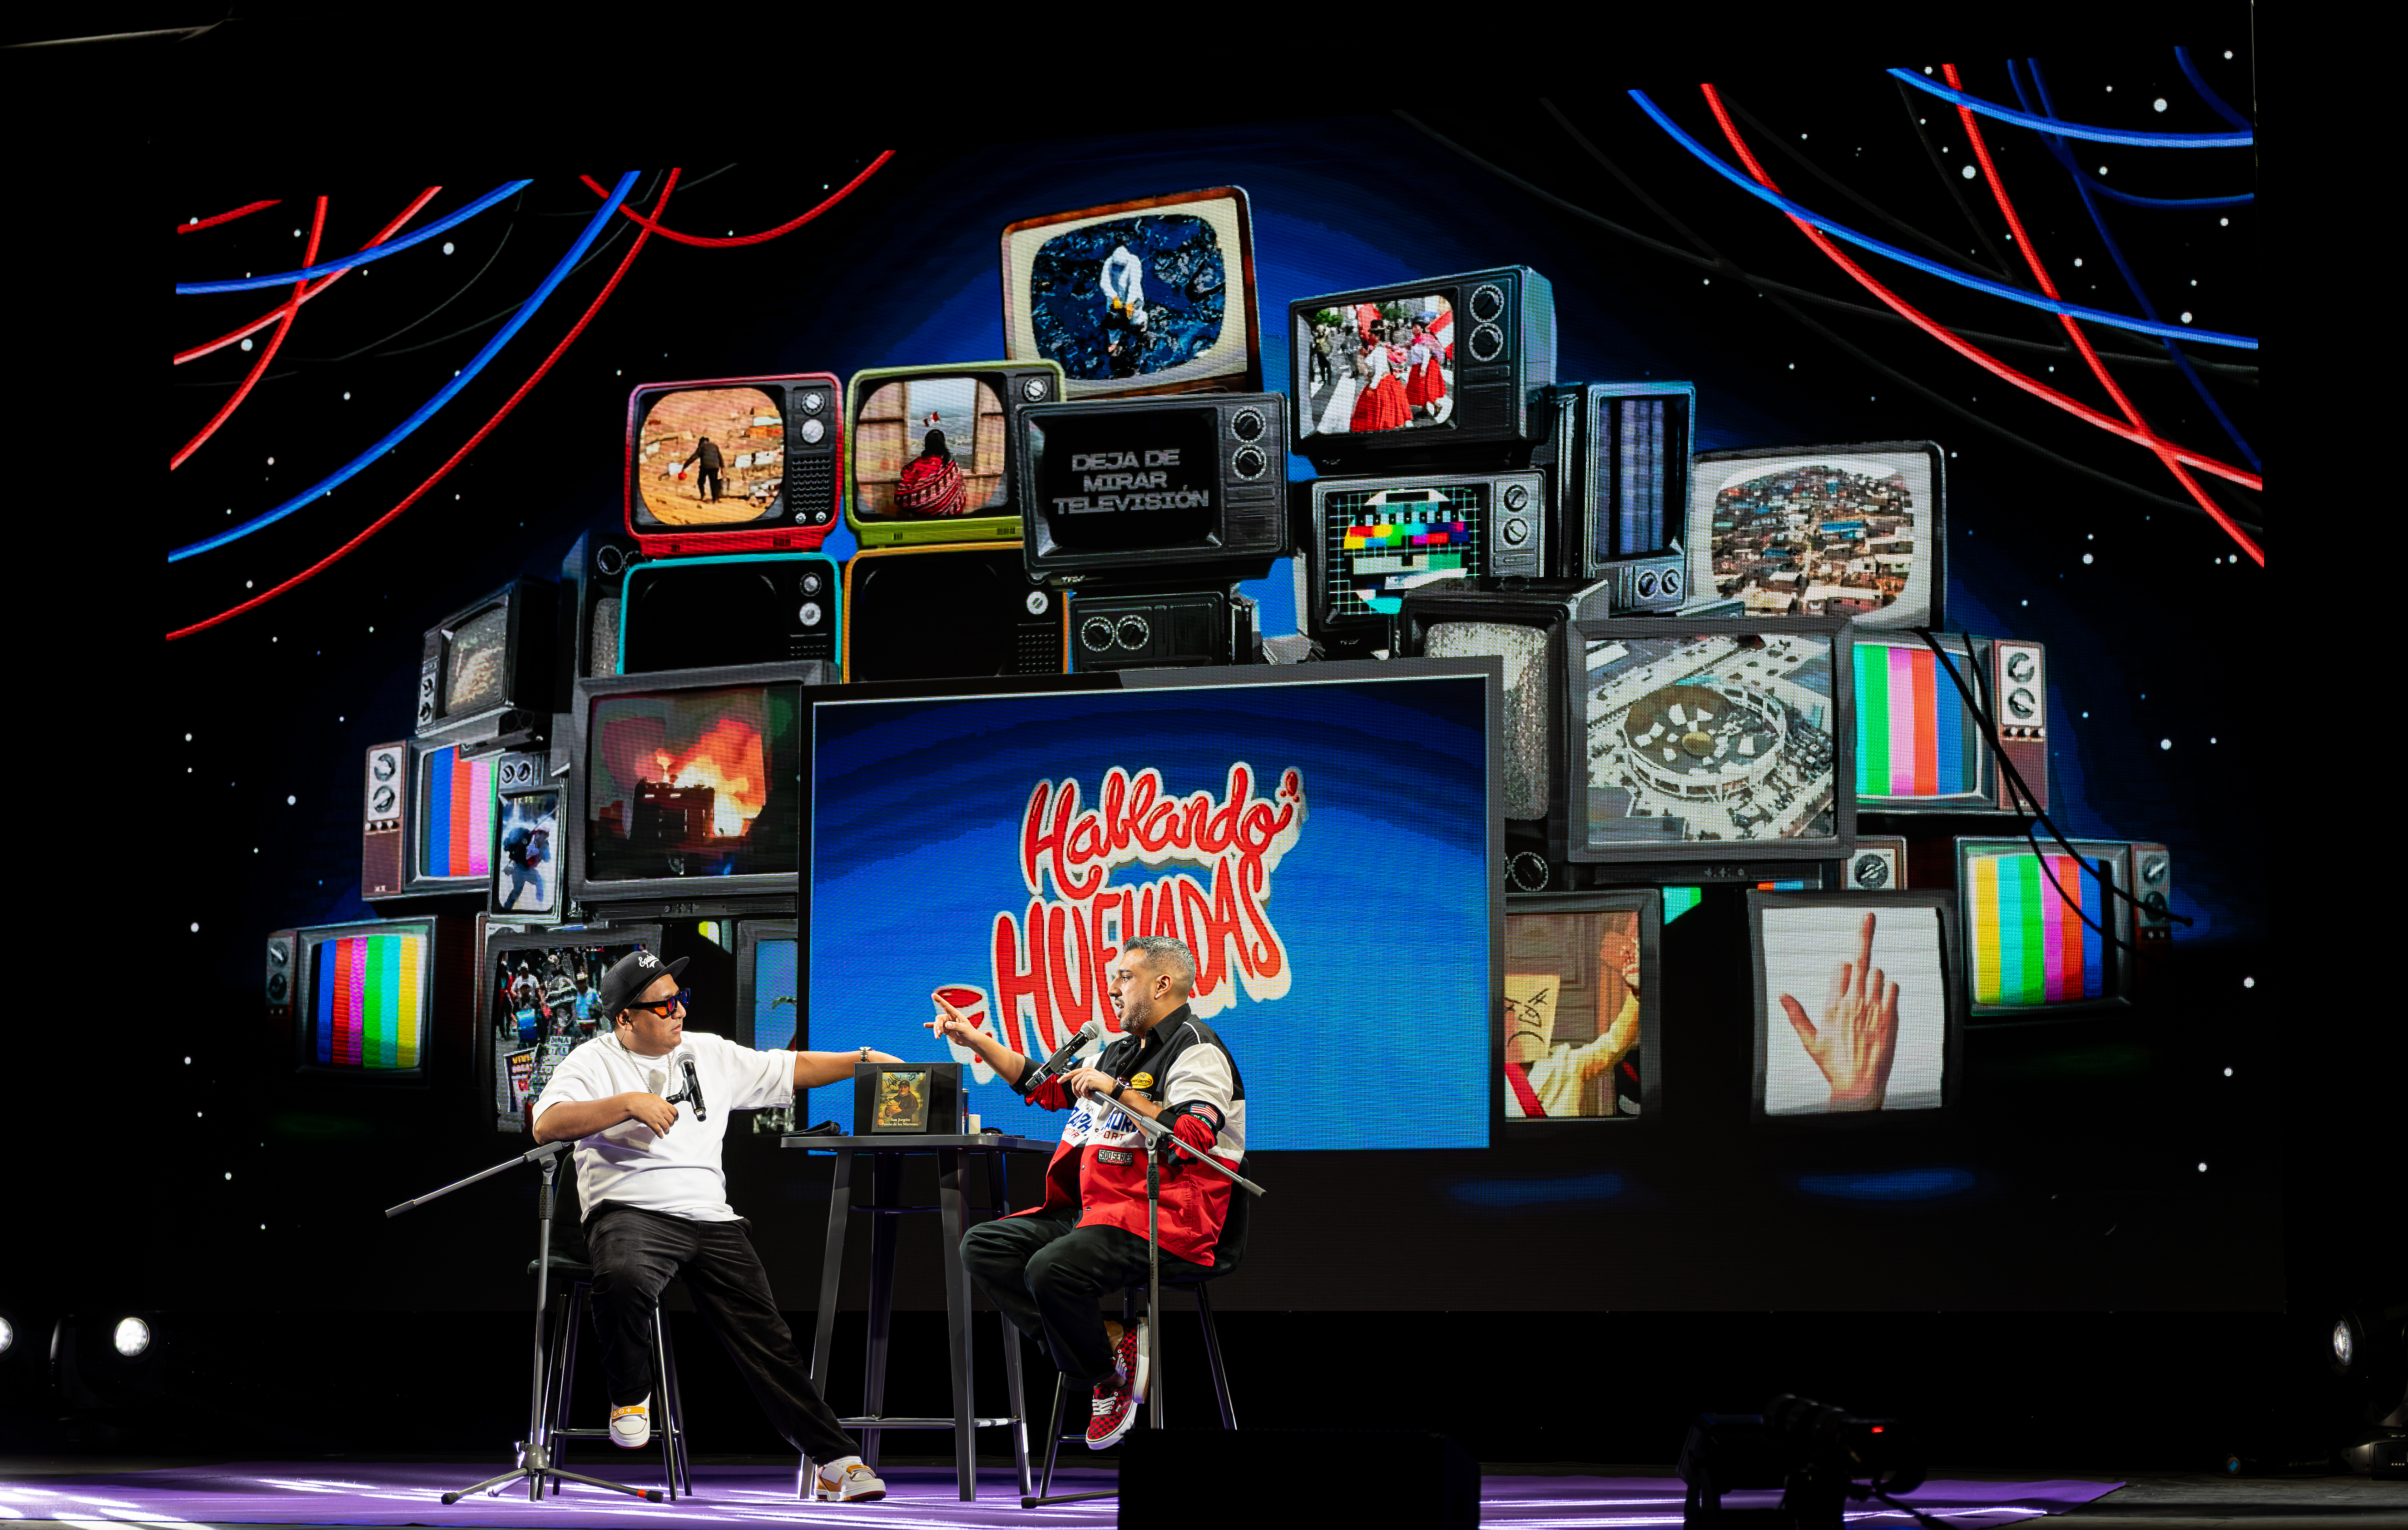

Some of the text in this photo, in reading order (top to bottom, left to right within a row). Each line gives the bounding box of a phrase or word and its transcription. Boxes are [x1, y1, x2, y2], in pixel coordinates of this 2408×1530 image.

[1072, 449, 1180, 472] DEJA DE
[1084, 471, 1168, 492] MIRAR
[1053, 485, 1209, 515] TELEVISIÓN
[1024, 766, 1294, 901] Hablando
[1100, 1150, 1132, 1162] 500 SERIES
